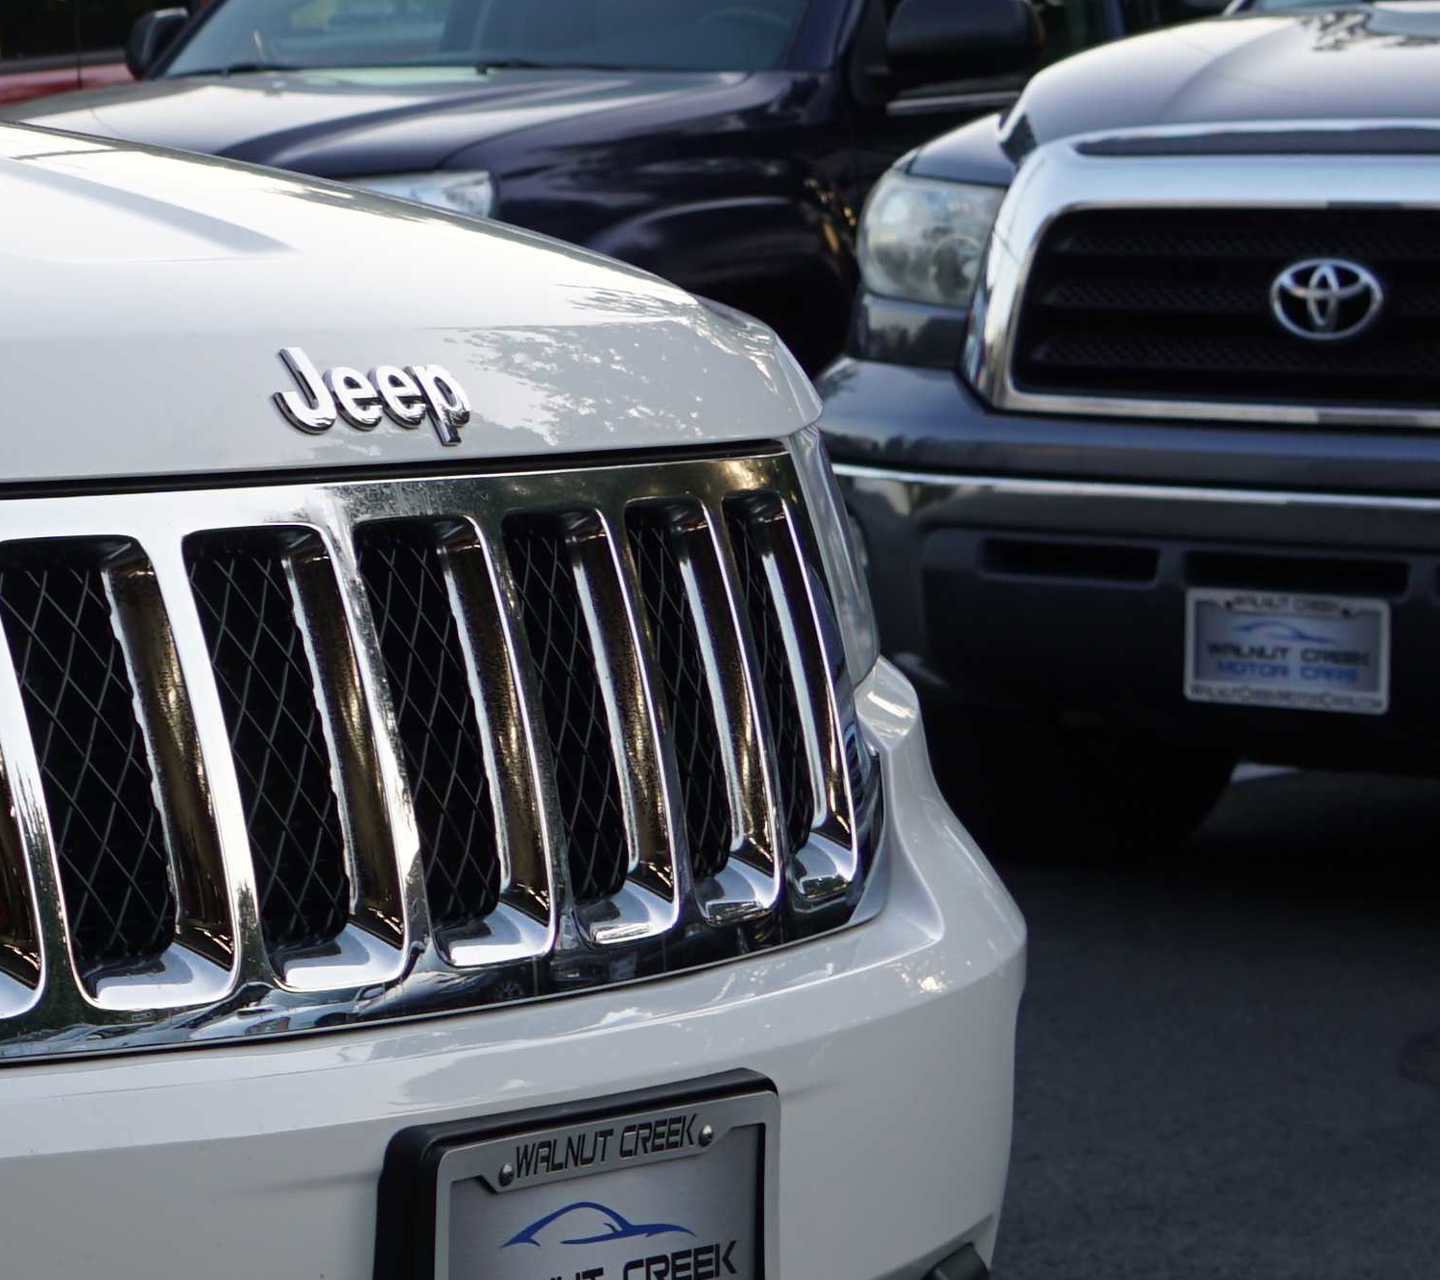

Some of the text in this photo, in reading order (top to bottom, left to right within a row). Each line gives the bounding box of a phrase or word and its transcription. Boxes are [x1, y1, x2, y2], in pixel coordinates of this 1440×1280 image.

[271, 347, 471, 447] Jeep
[515, 1113, 699, 1180] WALNUT CREEK
